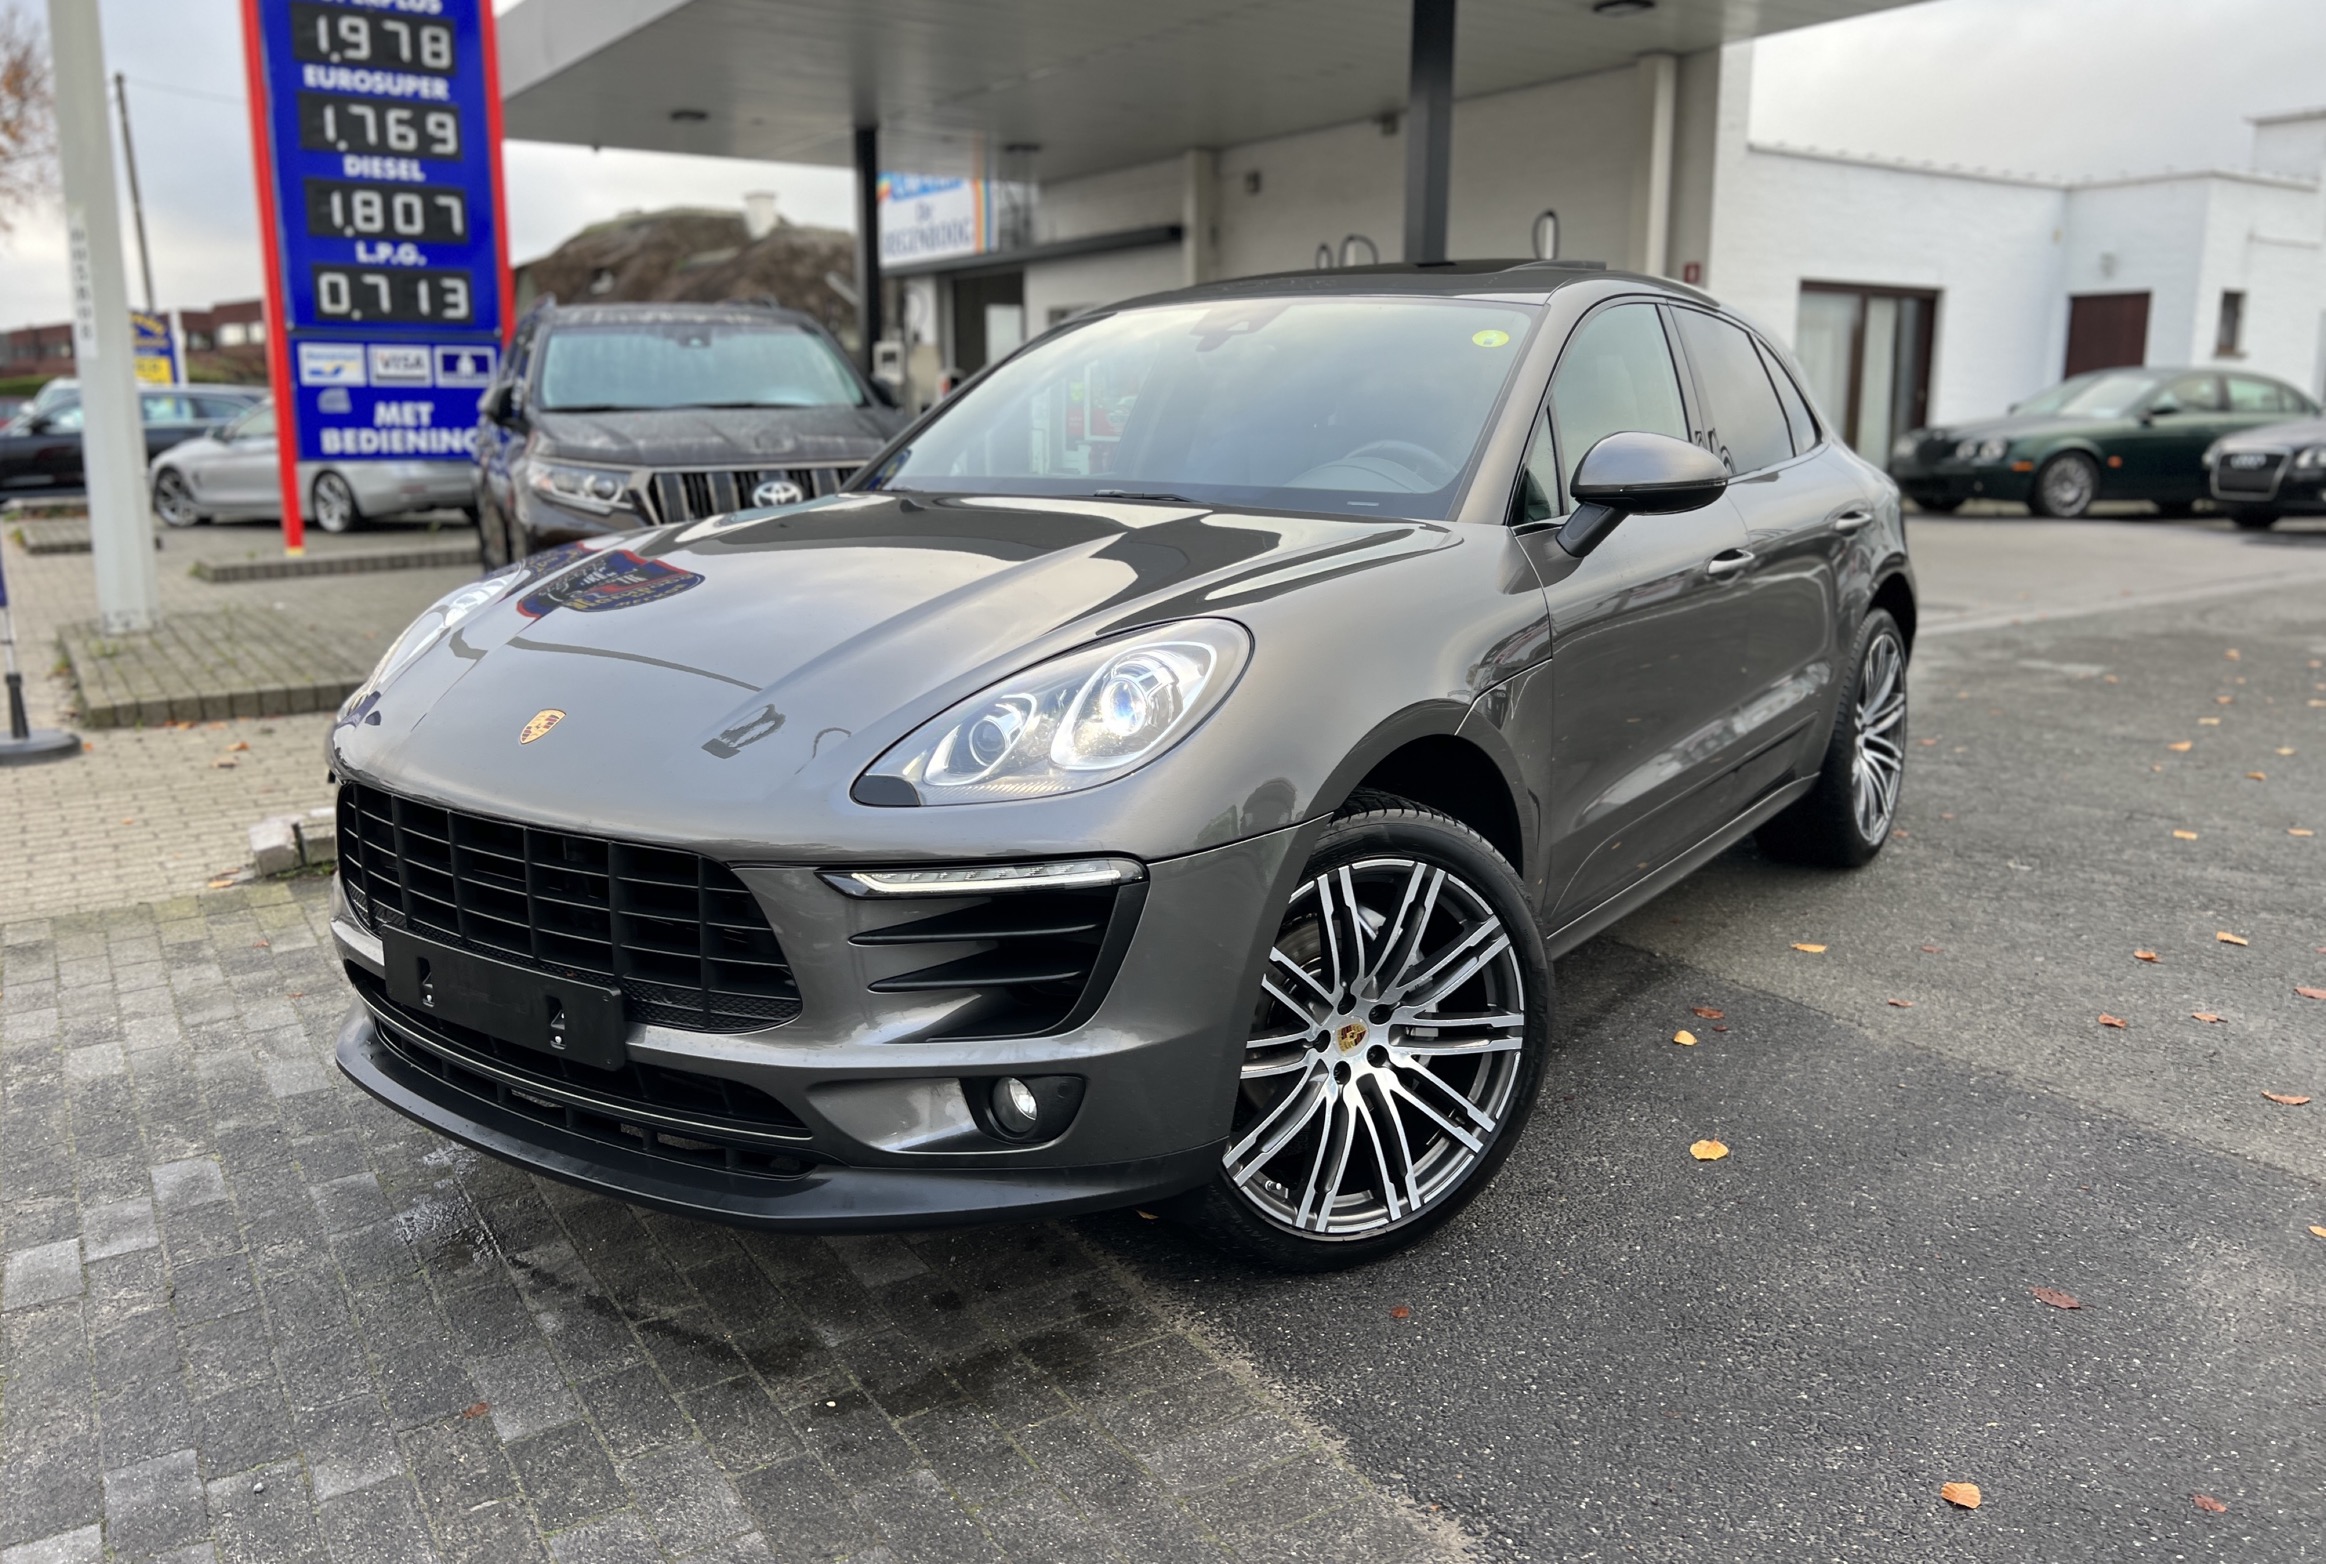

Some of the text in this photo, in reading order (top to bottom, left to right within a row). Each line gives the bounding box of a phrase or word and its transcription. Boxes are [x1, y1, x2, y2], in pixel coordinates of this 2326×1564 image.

[302, 64, 450, 100] EUROSUPER
[343, 155, 425, 181] DIESEL
[355, 241, 427, 266] L.P.G.
[373, 401, 435, 428] MET
